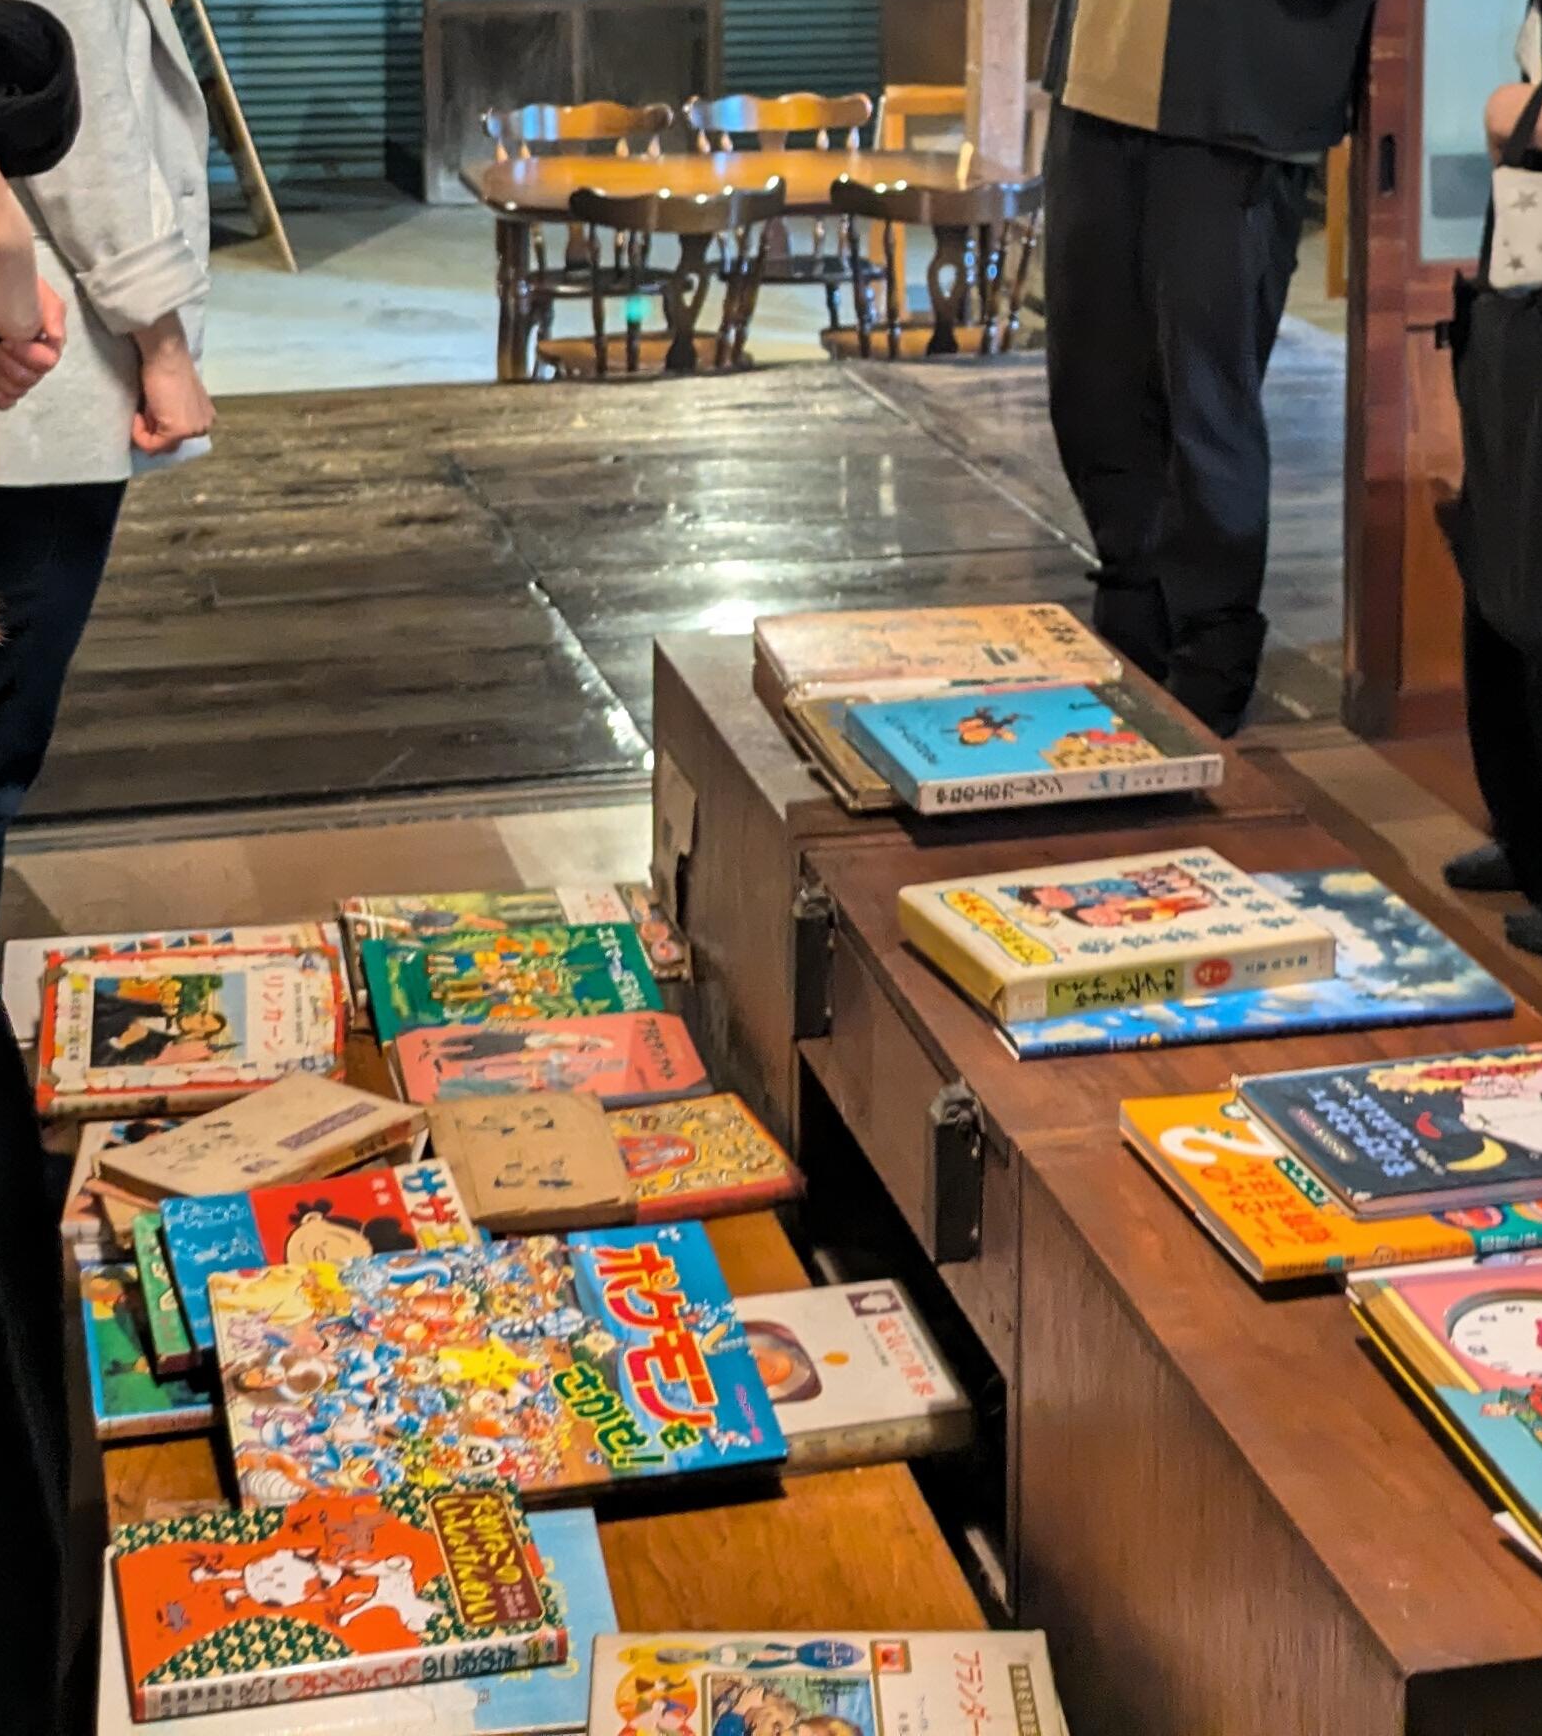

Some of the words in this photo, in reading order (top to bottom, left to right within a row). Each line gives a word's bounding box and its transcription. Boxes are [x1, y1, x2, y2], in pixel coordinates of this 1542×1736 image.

[260, 973, 287, 1058] リンカーン
[592, 1242, 720, 1451] ポケモンを
